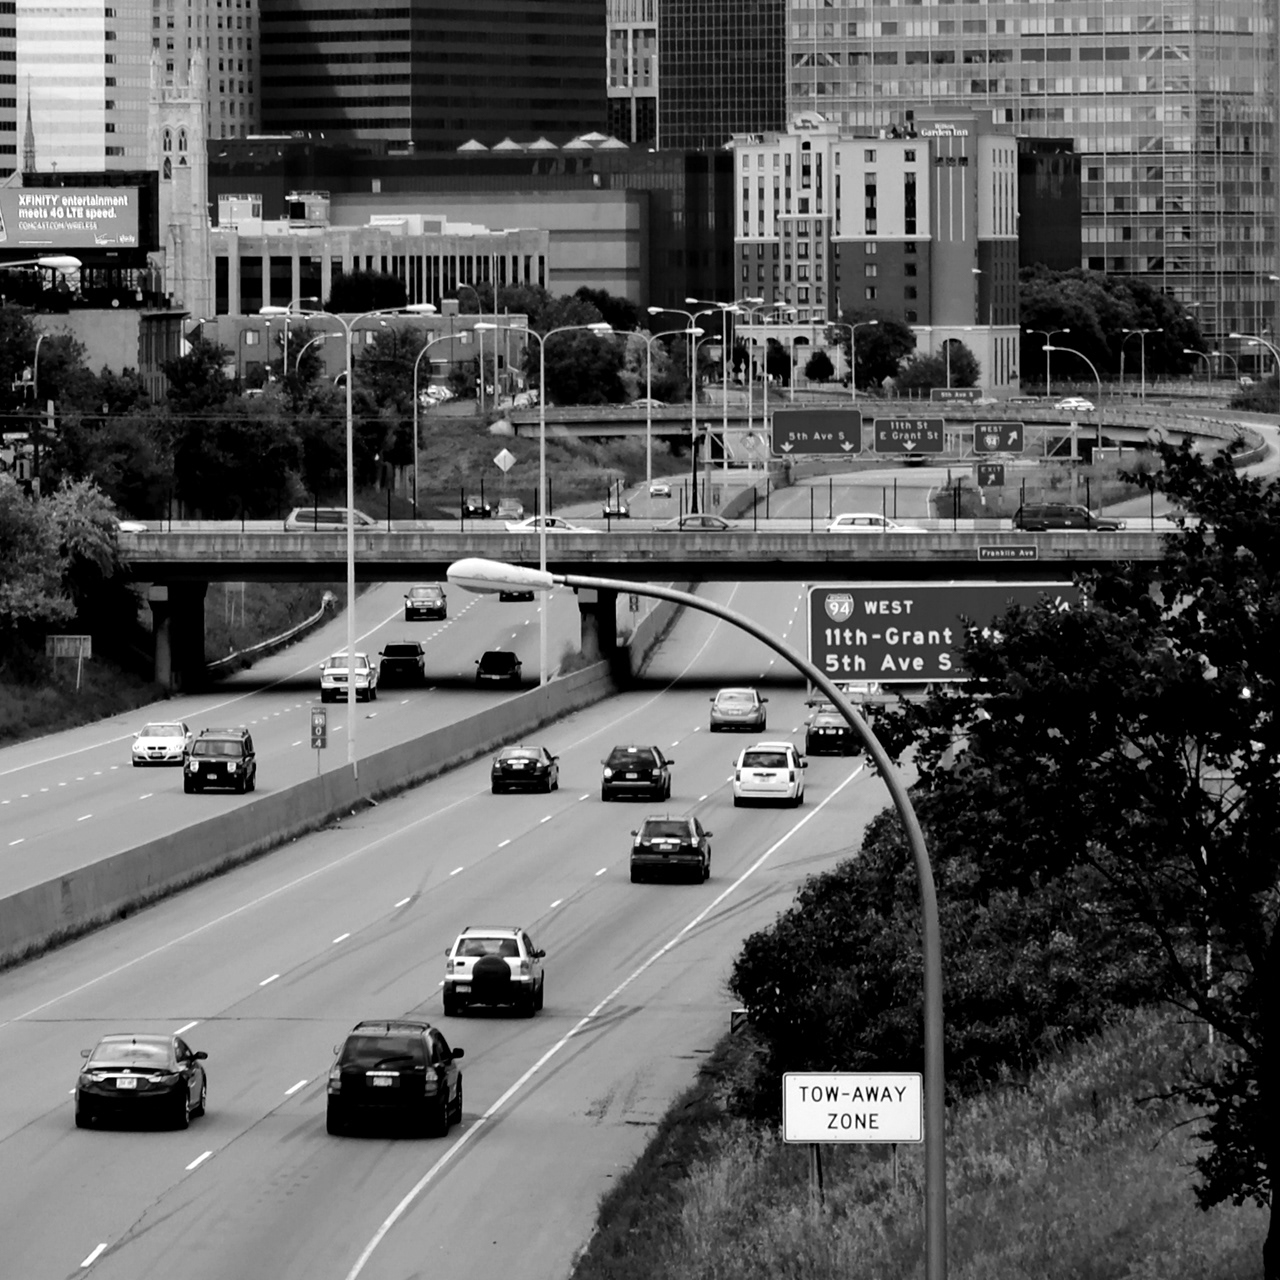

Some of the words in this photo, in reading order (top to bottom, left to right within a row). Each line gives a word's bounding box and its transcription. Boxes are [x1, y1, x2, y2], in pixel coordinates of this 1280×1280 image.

[921, 128, 952, 136] Garden
[19, 194, 56, 206] XFINITY
[62, 194, 128, 206] entertainment
[19, 207, 48, 218] meets
[50, 207, 64, 218] 4G
[66, 207, 83, 218] LTE
[86, 207, 117, 219] speed.
[890, 421, 912, 430] 11th
[917, 421, 928, 430] St
[789, 432, 808, 441] 5th
[814, 432, 833, 440] Ave
[838, 431, 845, 440] S
[880, 431, 887, 440] E
[892, 431, 922, 440] Grant
[927, 431, 939, 440] St
[985, 436, 997, 446] 94
[982, 549, 1015, 557] Franklin
[829, 602, 850, 616] 94
[864, 600, 913, 615] WEST
[825, 627, 952, 646] 11th-Grant
[826, 654, 866, 671] 5th
[880, 654, 925, 671] Ave
[938, 653, 952, 671] S
[315, 726, 322, 736] 0
[798, 1086, 908, 1104] TOW-AWAY
[827, 1113, 880, 1131] ZONE
